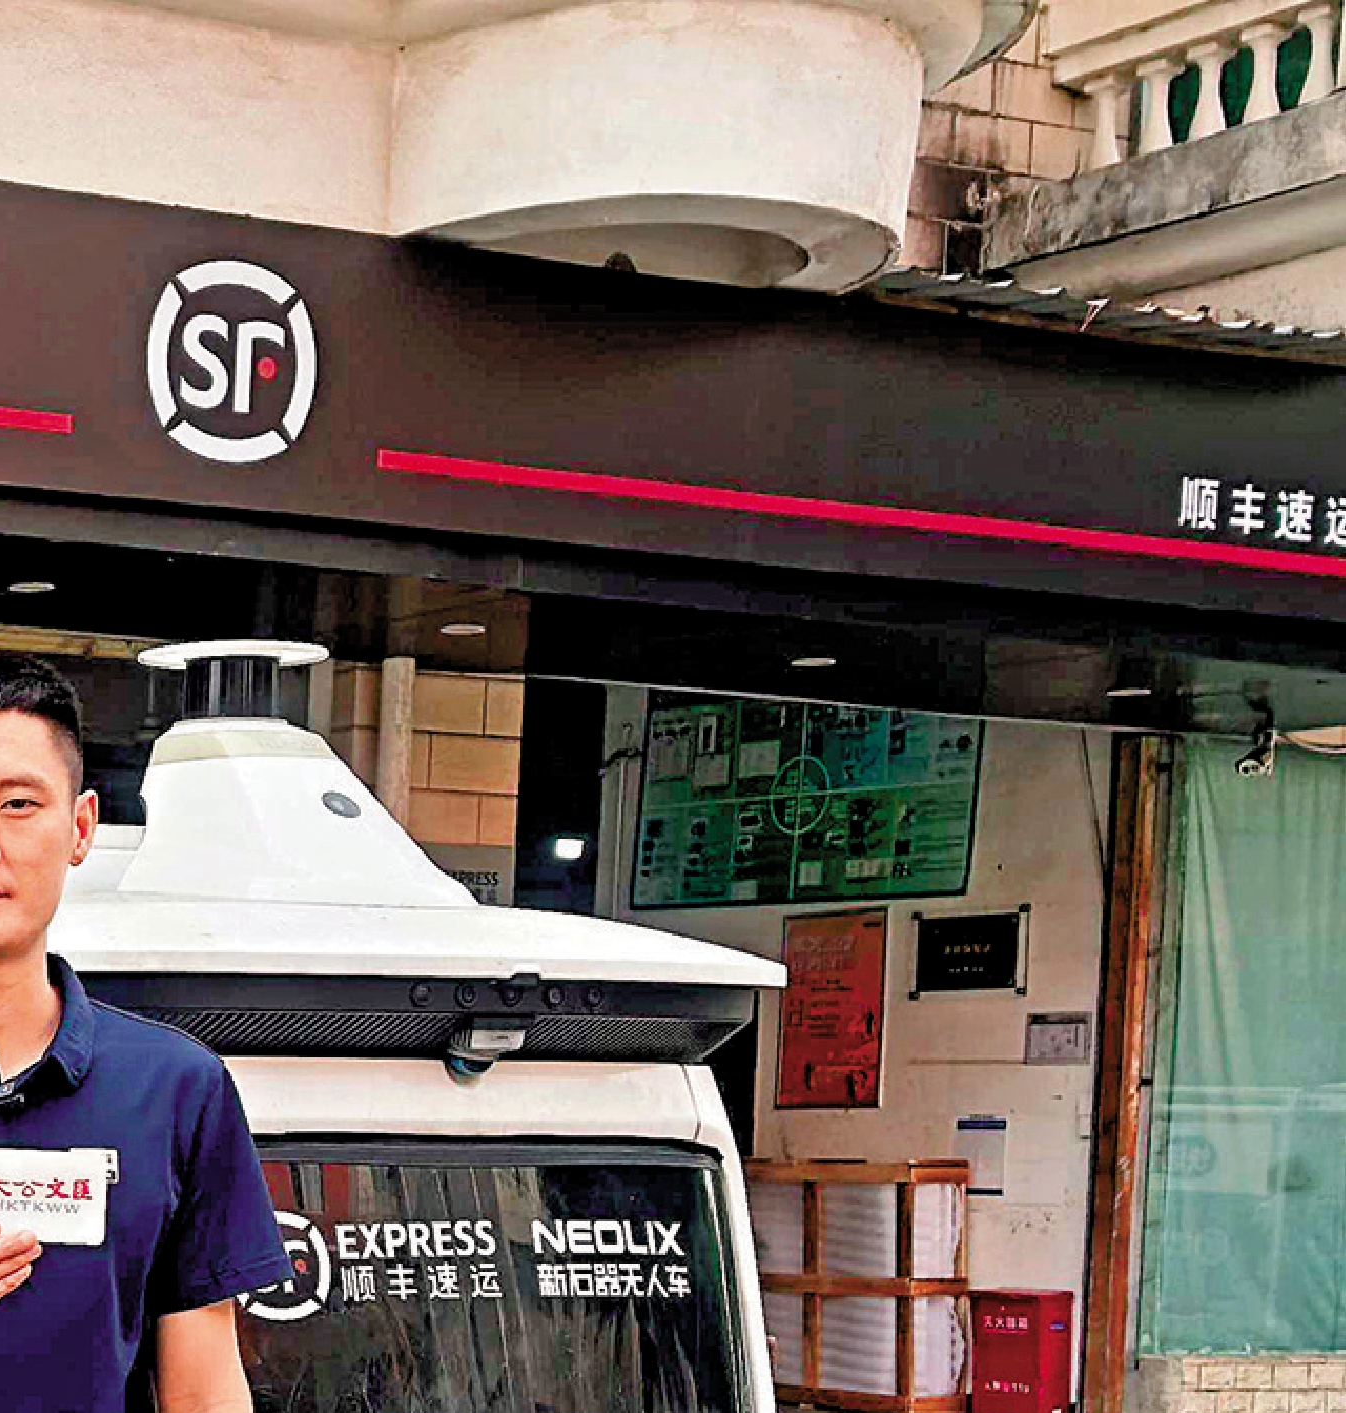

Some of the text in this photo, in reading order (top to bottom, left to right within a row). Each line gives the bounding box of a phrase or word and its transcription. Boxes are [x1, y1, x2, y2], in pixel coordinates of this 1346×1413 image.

[179, 313, 286, 413] SF
[335, 1219, 496, 1260] EXPRESS
[532, 1219, 685, 1256] NEOLIX
[341, 1263, 504, 1301] 顺丰速运
[538, 1262, 692, 1298] 新石器无人车
